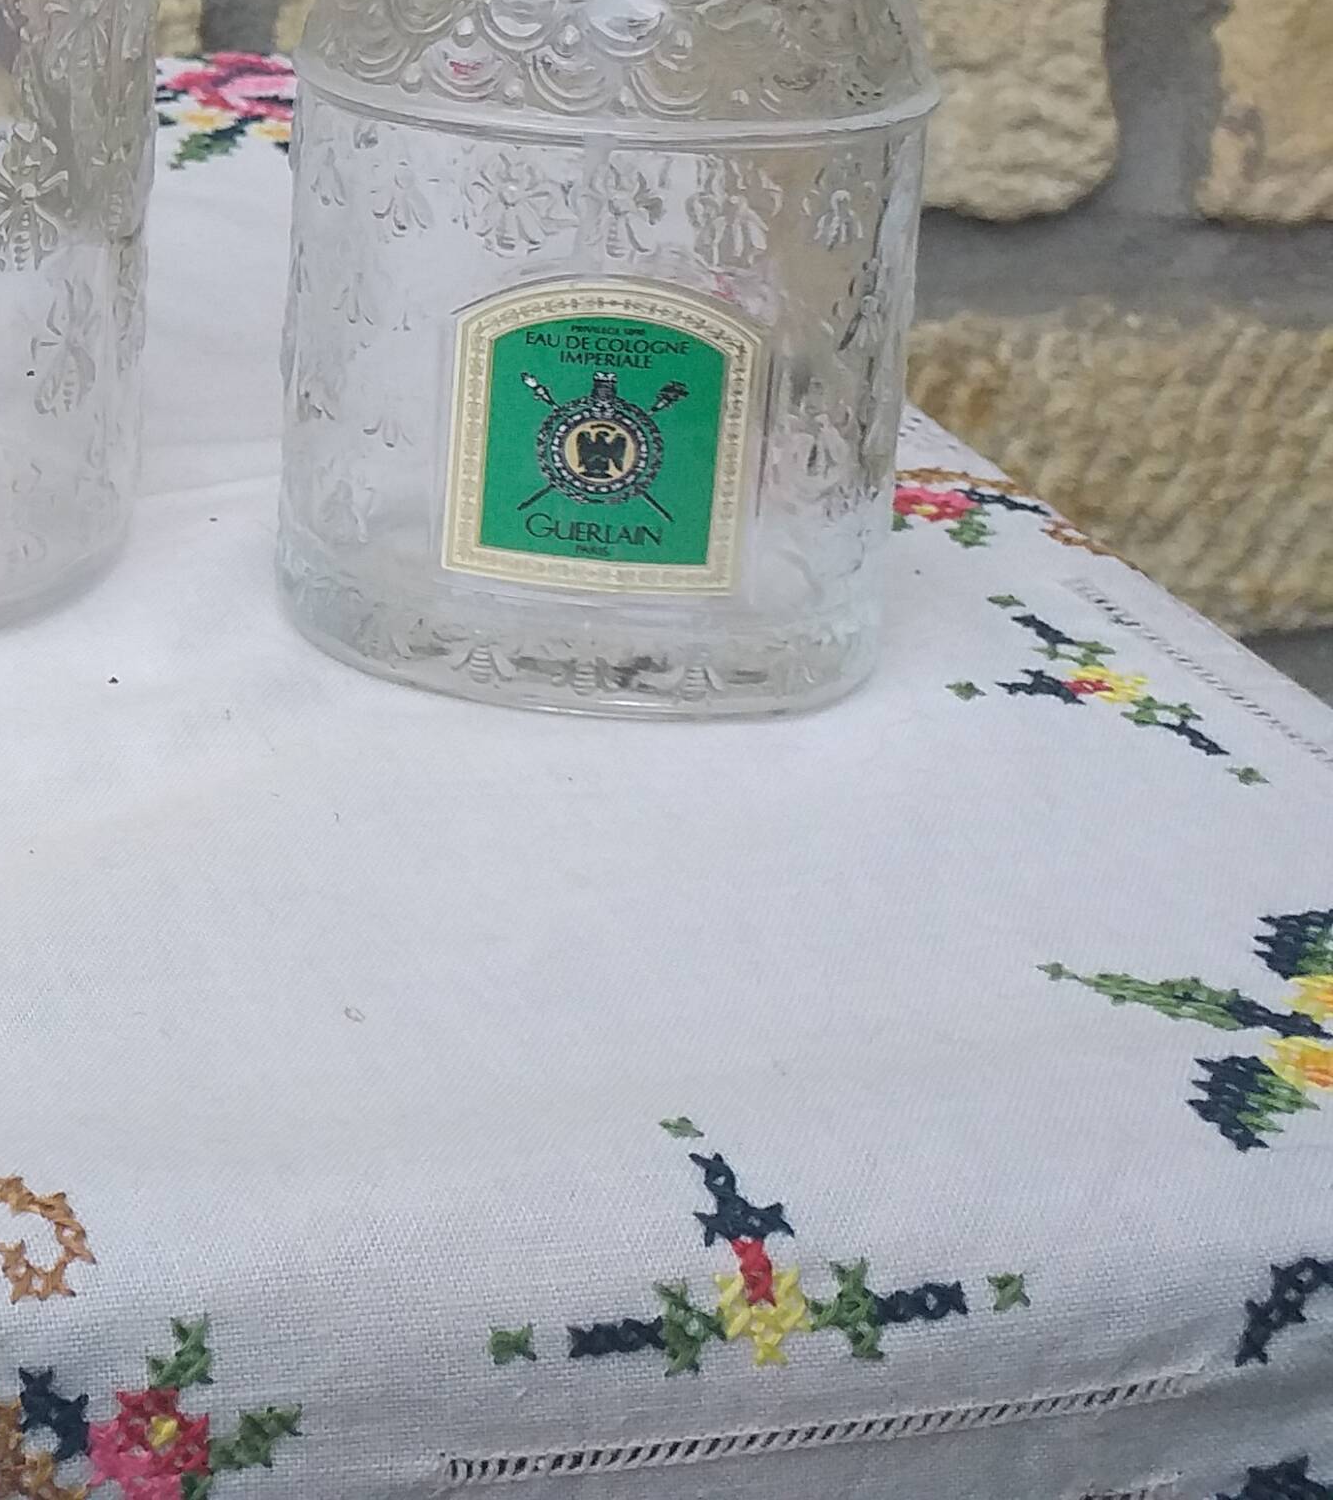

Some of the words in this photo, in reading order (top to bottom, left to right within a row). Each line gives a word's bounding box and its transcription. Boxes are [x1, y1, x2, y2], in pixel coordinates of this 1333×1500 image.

[525, 331, 560, 348] EAU
[565, 335, 590, 350] DE
[595, 337, 690, 355] COLOGNE
[560, 350, 652, 369] IMPERIALE
[525, 513, 663, 545] GUERLAIN
